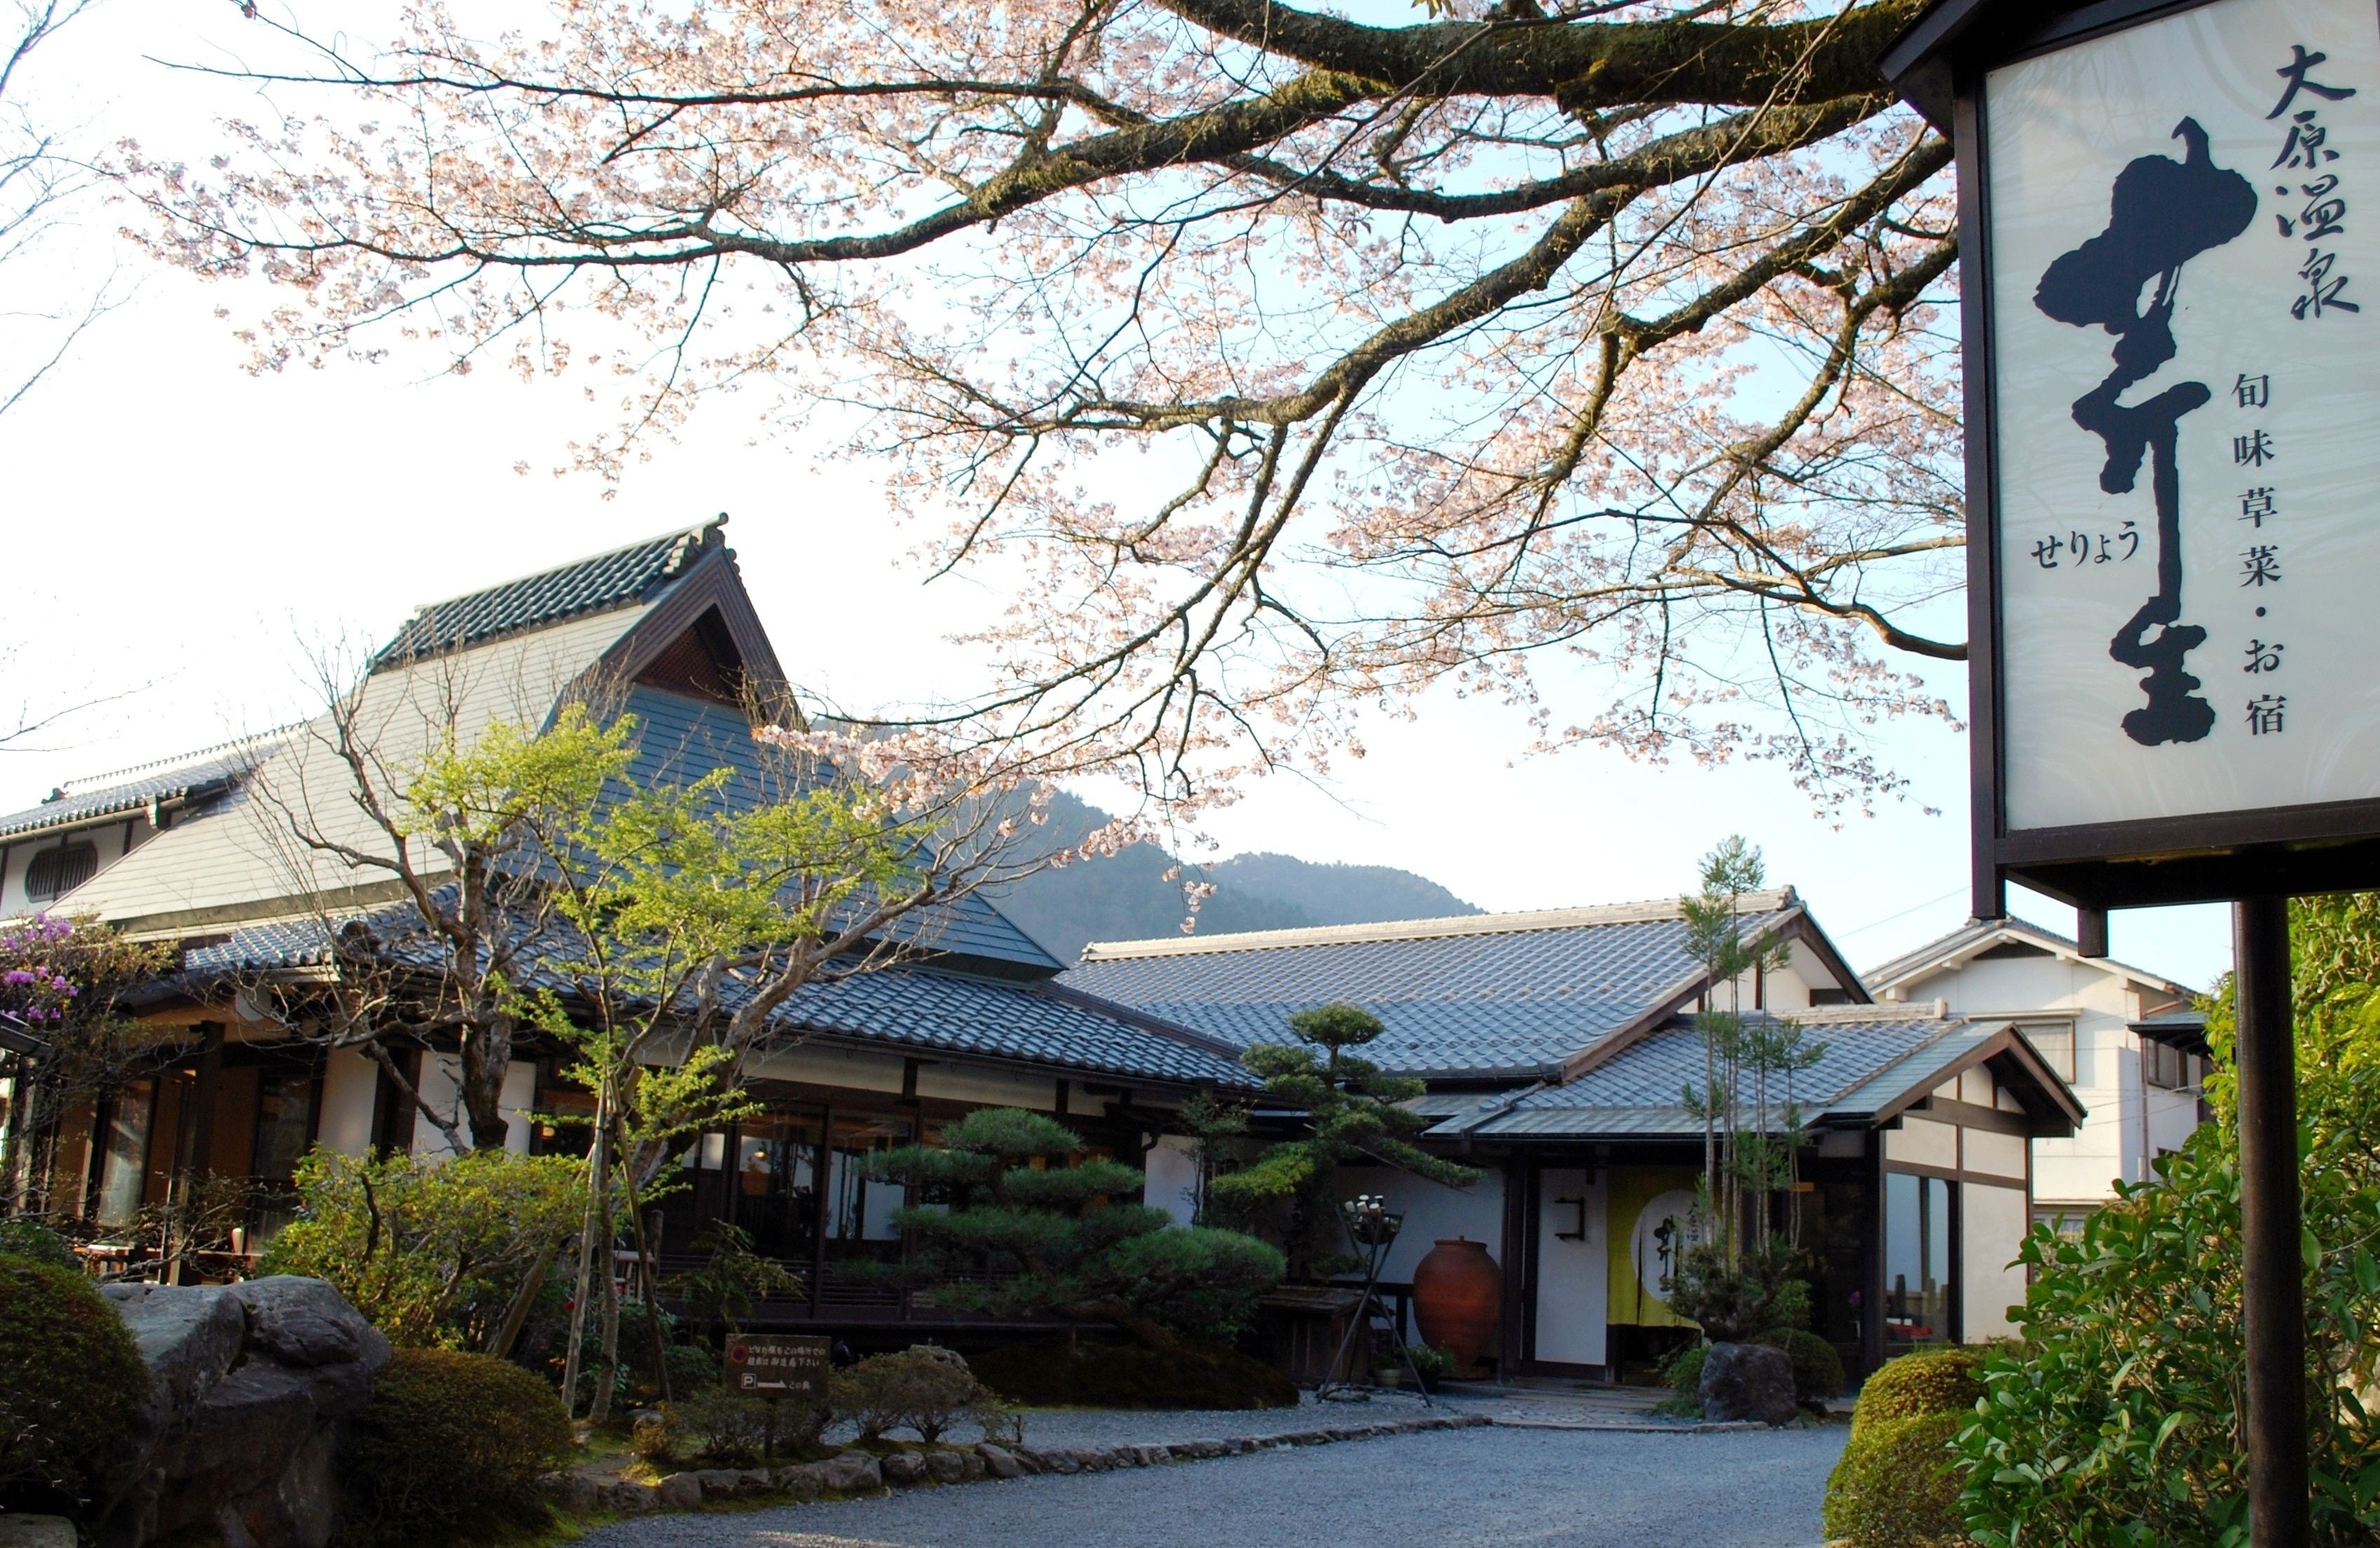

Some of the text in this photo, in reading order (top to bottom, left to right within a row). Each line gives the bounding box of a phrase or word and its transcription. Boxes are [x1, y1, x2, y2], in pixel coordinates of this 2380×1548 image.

[2265, 44, 2360, 320] 大原温泉
[2031, 521, 2139, 569] せりょう
[2231, 373, 2287, 736] 旬味草菜・お宿
